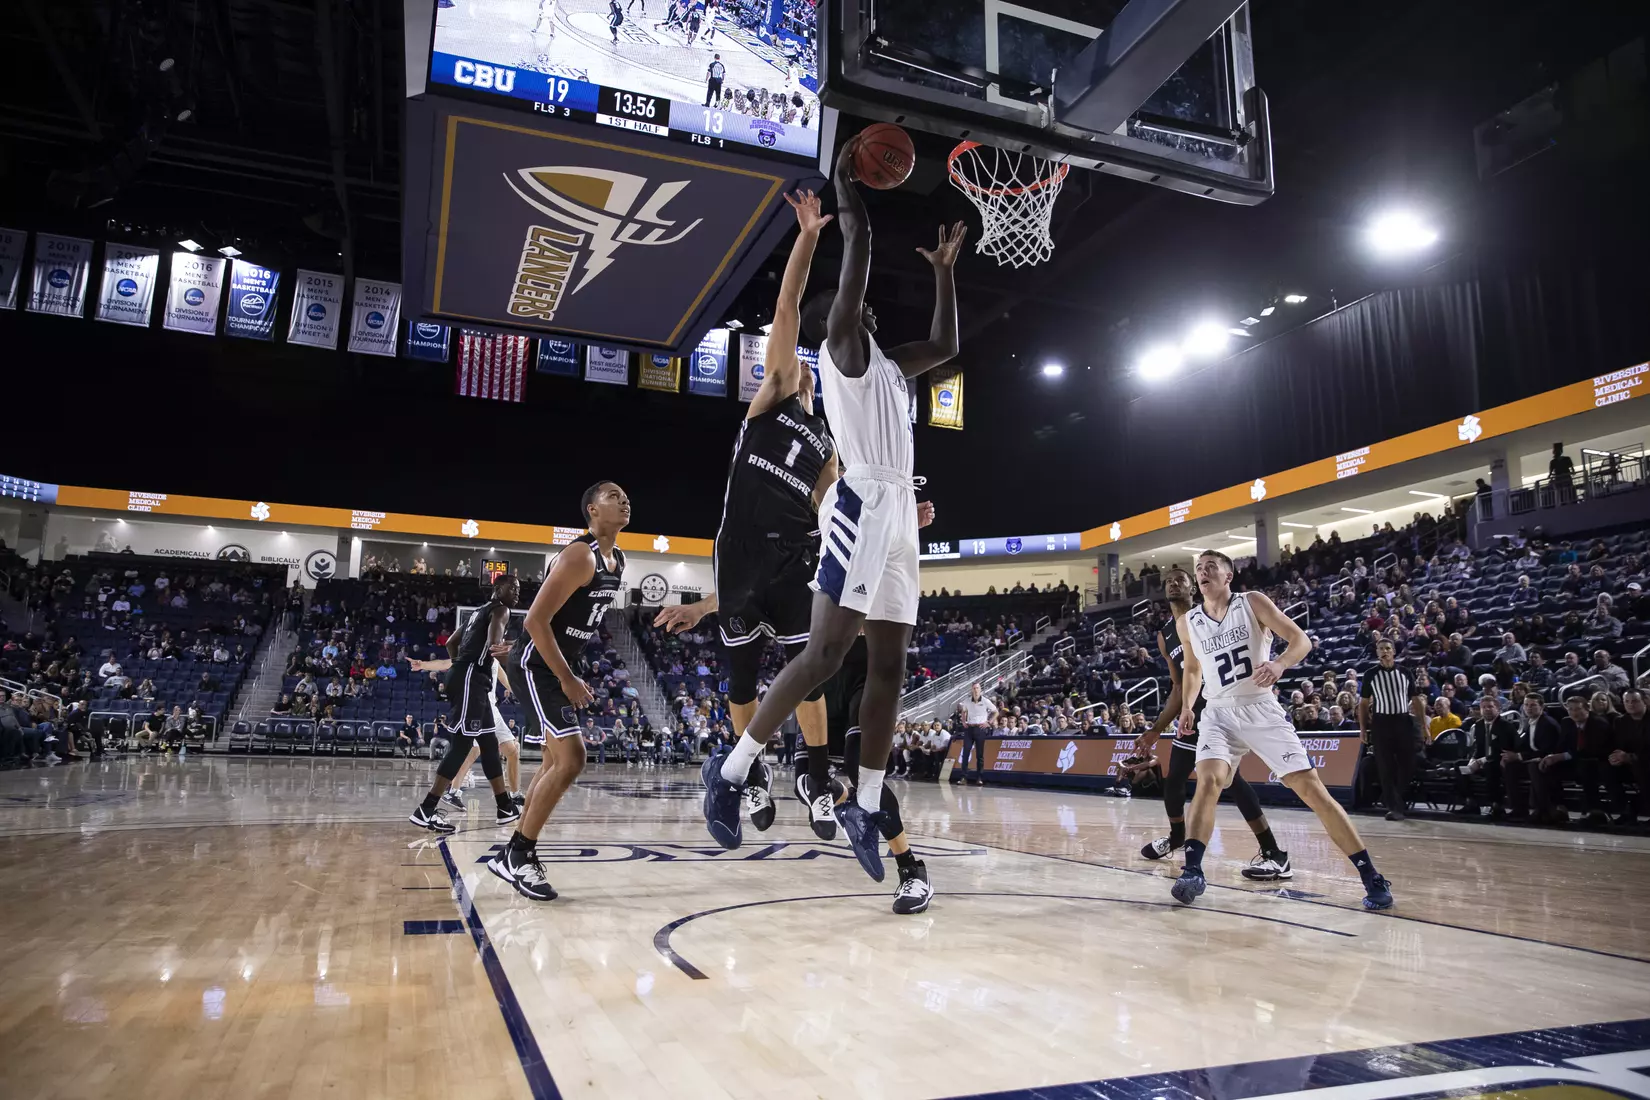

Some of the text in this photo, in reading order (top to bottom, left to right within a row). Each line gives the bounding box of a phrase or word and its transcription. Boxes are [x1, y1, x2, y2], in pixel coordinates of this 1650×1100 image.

[453, 59, 517, 93] CBU
[547, 77, 569, 103] 19
[534, 101, 571, 117] FLS 3
[614, 91, 656, 118] 13:56
[608, 116, 660, 134] 1ST HALF
[703, 110, 724, 134] 13
[691, 133, 724, 148] FLS 1
[48, 241, 80, 252] 2018
[104, 266, 150, 278] BASKETBAL
[244, 268, 271, 280] 016
[505, 224, 586, 322] LANCERS
[243, 278, 266, 286] MEN'S
[306, 276, 334, 288] 2015
[307, 287, 329, 296] MEN'S
[364, 285, 391, 296] 2014
[107, 298, 138, 308] DIVISION
[296, 292, 339, 304] BASKETBALL
[100, 302, 148, 315] TOURNAMENT
[175, 307, 205, 316] DIVISION
[168, 312, 214, 323] TOURNAMENT
[295, 322, 326, 332] DIVISION
[297, 329, 320, 338] SWEET
[358, 330, 384, 339] DIVISION
[590, 366, 624, 374] CHAMPIONS
[1593, 363, 1649, 386] RIVERSIDE
[689, 376, 725, 385] CHAMPIONS
[1594, 376, 1643, 397] MEDICAL
[1595, 390, 1630, 407] CLINIC
[776, 412, 826, 460] CENTRAL
[784, 439, 802, 468] 1
[748, 454, 811, 497] ARKANSAS
[129, 491, 167, 500] RIVERSIDE
[128, 498, 160, 506] MEDICAL
[352, 510, 385, 518] RIVERSIDE
[352, 516, 380, 524] MEDICAL
[154, 548, 211, 558] ACADEMICALLY
[928, 542, 950, 554] 13:56
[972, 540, 985, 554] 13
[260, 556, 300, 564] BIBLICALLY
[588, 590, 617, 598] CENTR
[1200, 625, 1250, 655] LANCERS
[1214, 644, 1253, 687] 25
[1000, 740, 1032, 749] RIVERSIDE
[1300, 739, 1340, 751] ERSIDE
[997, 751, 1023, 760] MEDICAL
[994, 762, 1014, 770] CLINIC
